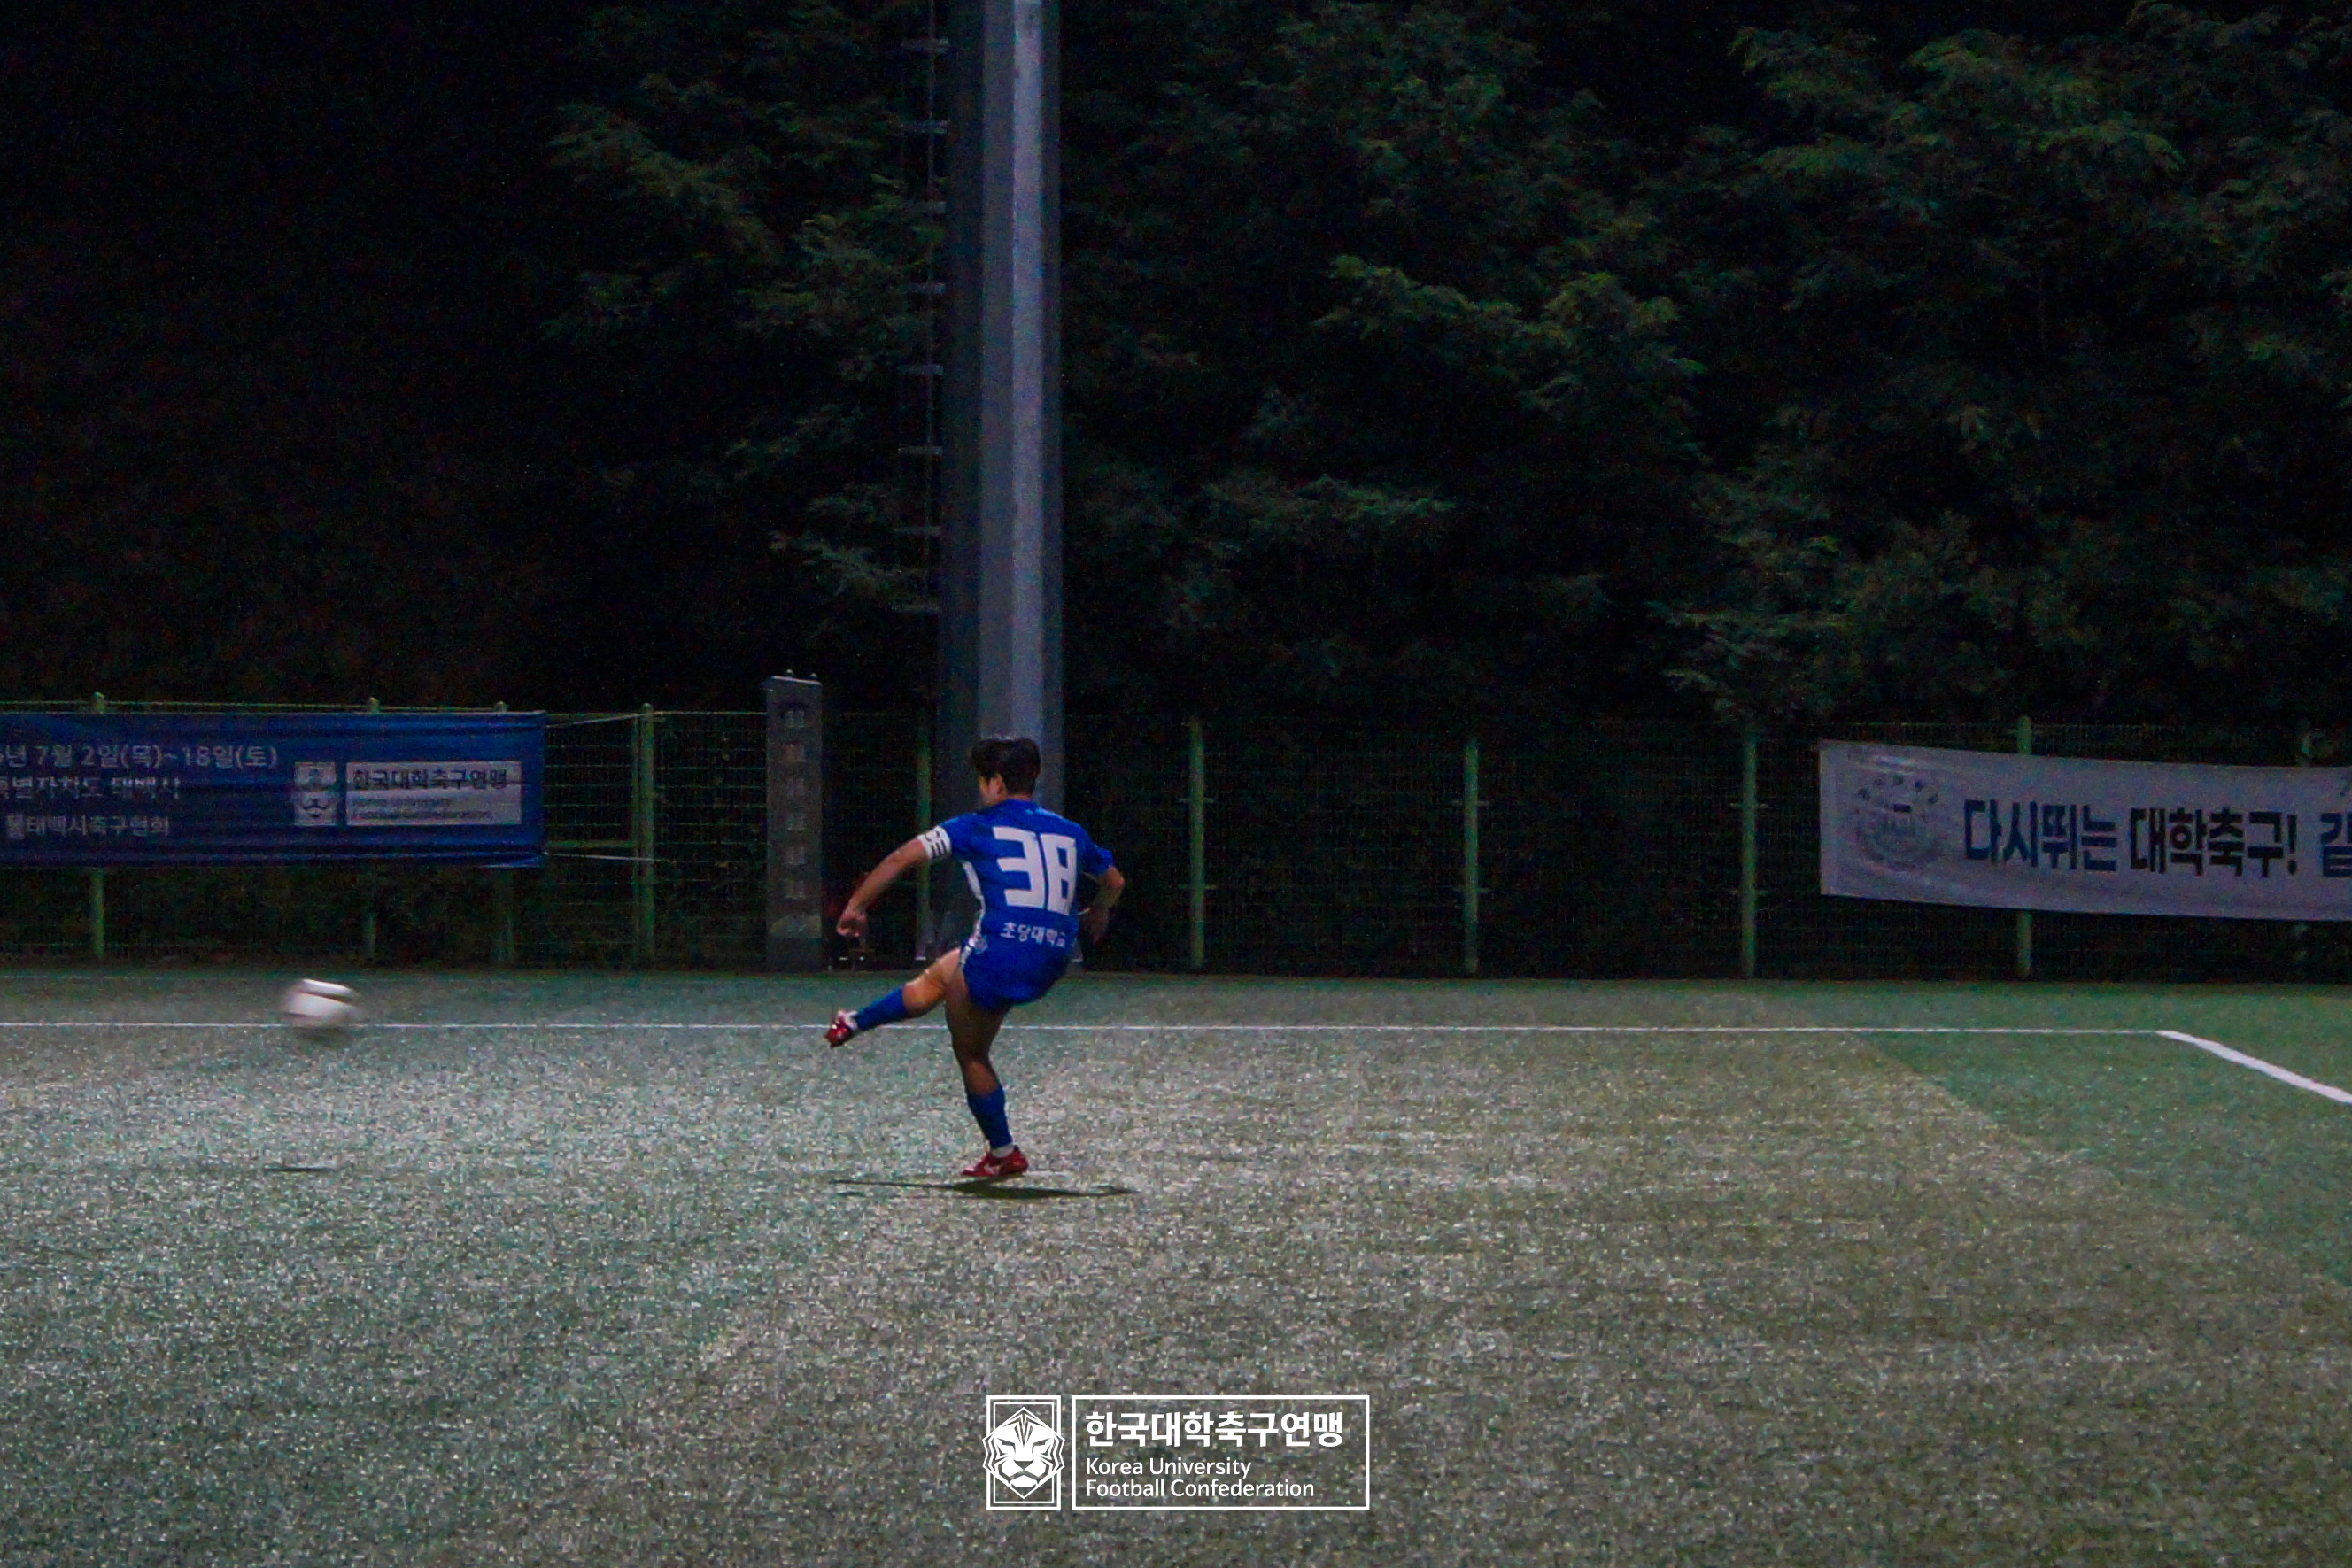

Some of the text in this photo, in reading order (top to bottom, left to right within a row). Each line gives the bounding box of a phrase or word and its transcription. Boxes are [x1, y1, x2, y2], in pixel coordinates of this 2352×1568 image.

[35, 745, 73, 769] 7월
[352, 769, 507, 791] 한국대학축구연맹
[1963, 799, 2117, 872] 다시뛰는
[2130, 807, 2298, 878] 대학축구!
[992, 826, 1077, 916] 38
